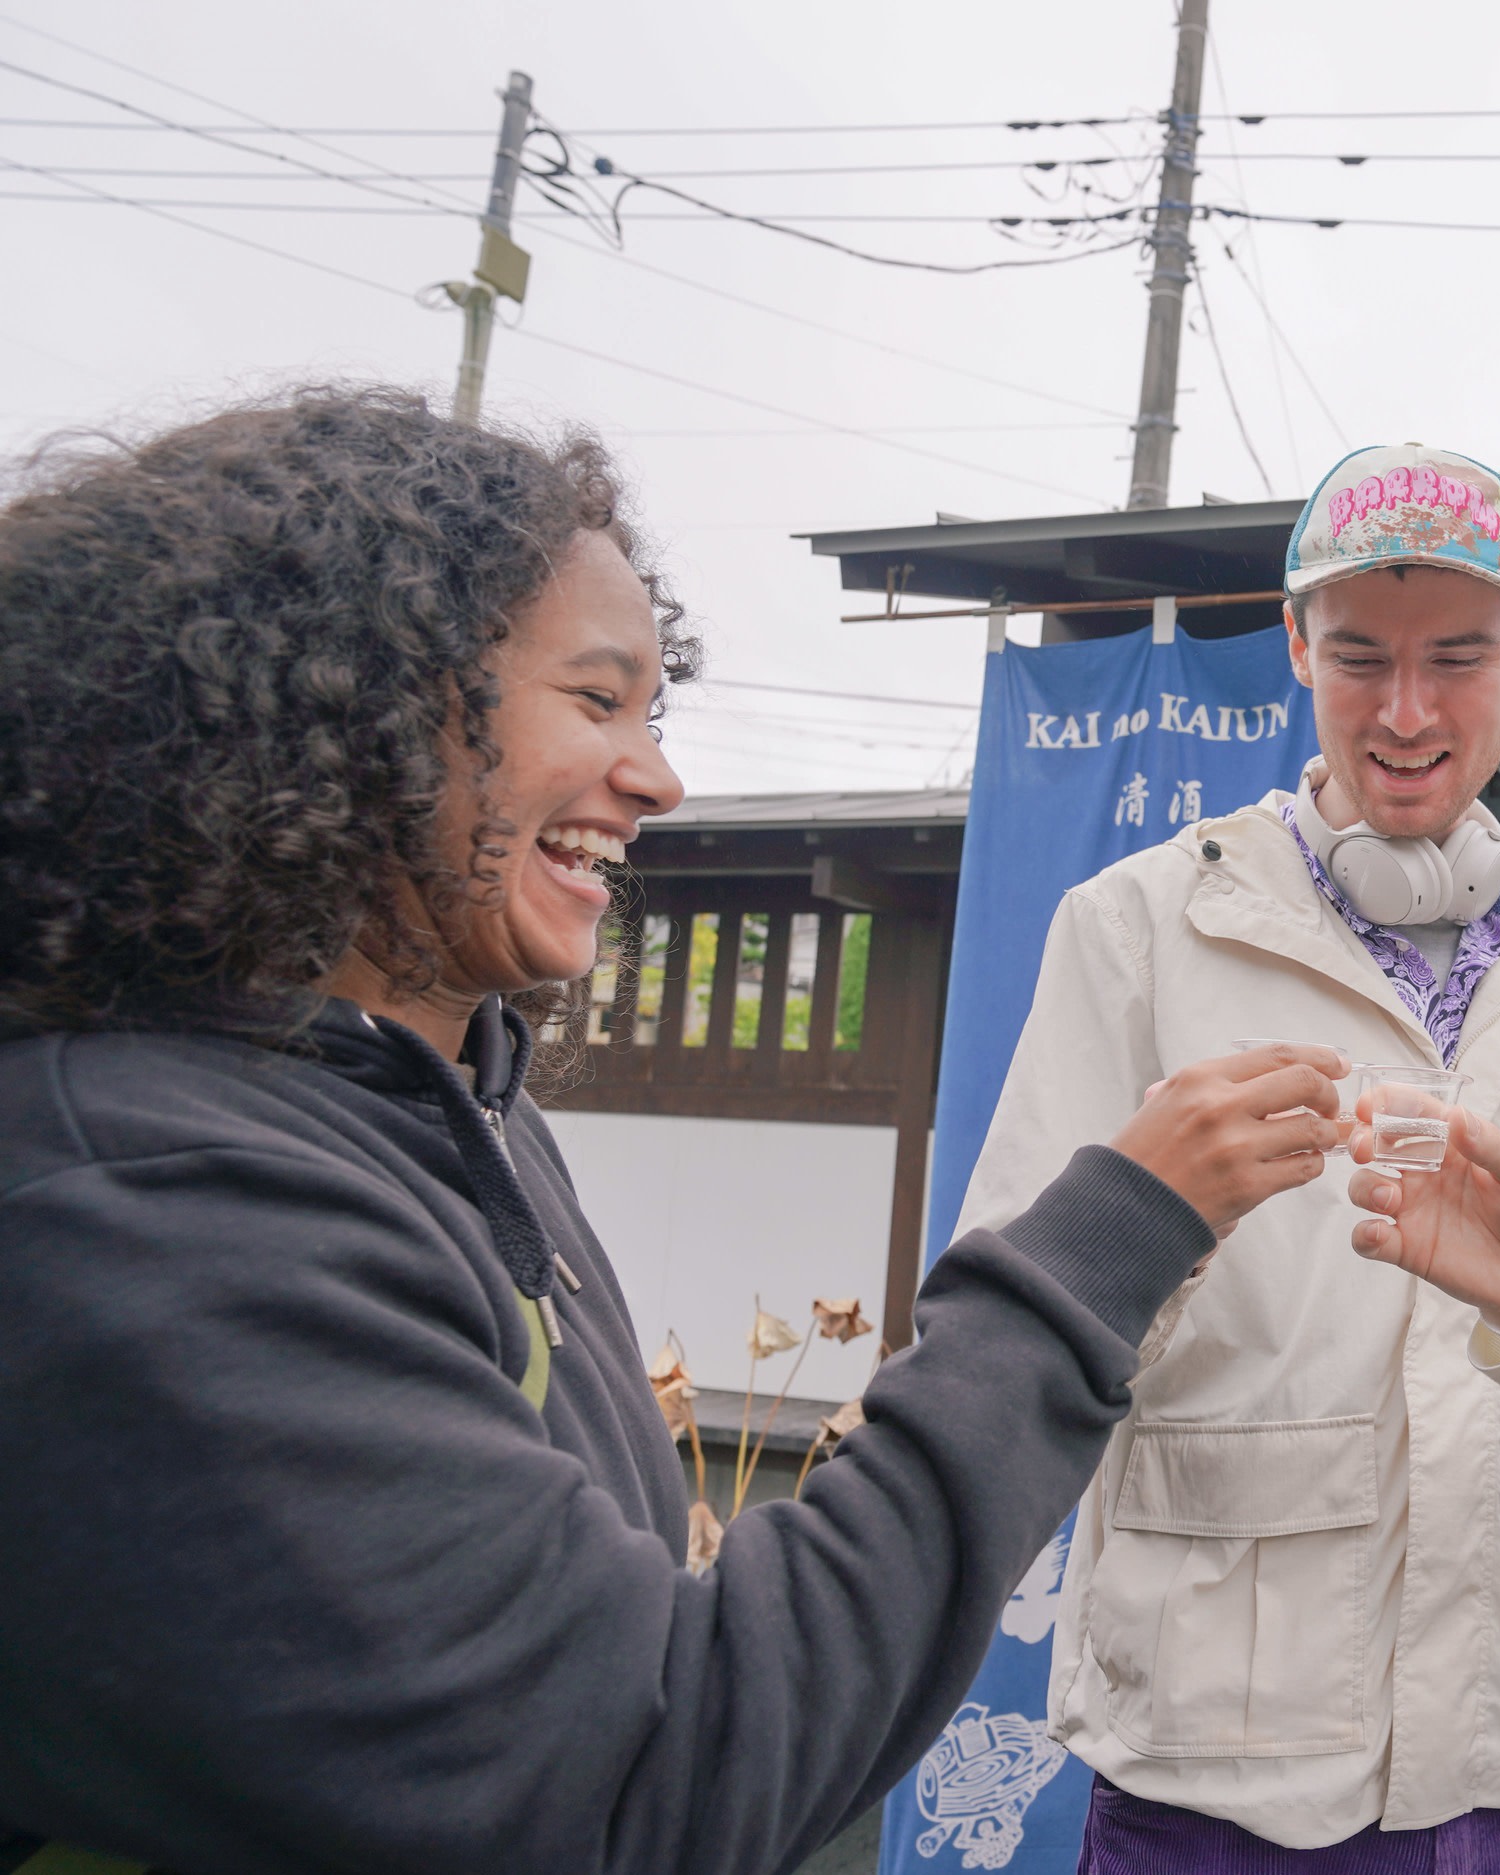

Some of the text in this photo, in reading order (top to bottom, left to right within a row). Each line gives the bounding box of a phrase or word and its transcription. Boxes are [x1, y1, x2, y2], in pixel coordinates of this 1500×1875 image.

[1026, 692, 1292, 749] KAI no KAIUN
[1114, 772, 1203, 827] 清酒
